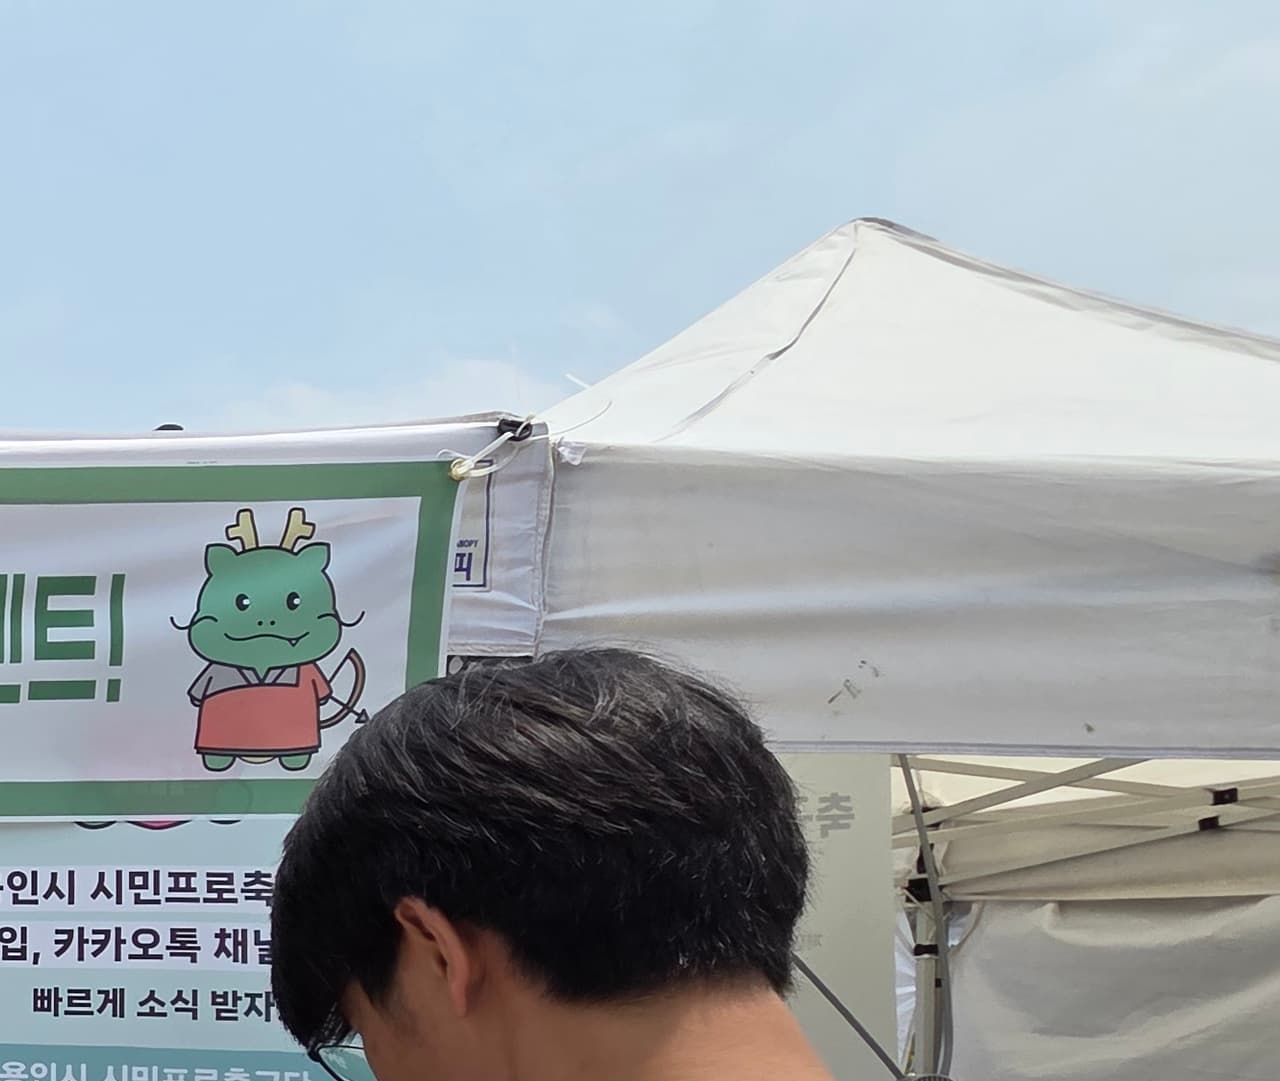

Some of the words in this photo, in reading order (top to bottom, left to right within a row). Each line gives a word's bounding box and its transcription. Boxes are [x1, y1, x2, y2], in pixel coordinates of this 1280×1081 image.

[54, 927, 201, 963] 카카오톡
[32, 988, 126, 1019] 빠르게
[137, 989, 199, 1020] 소식
